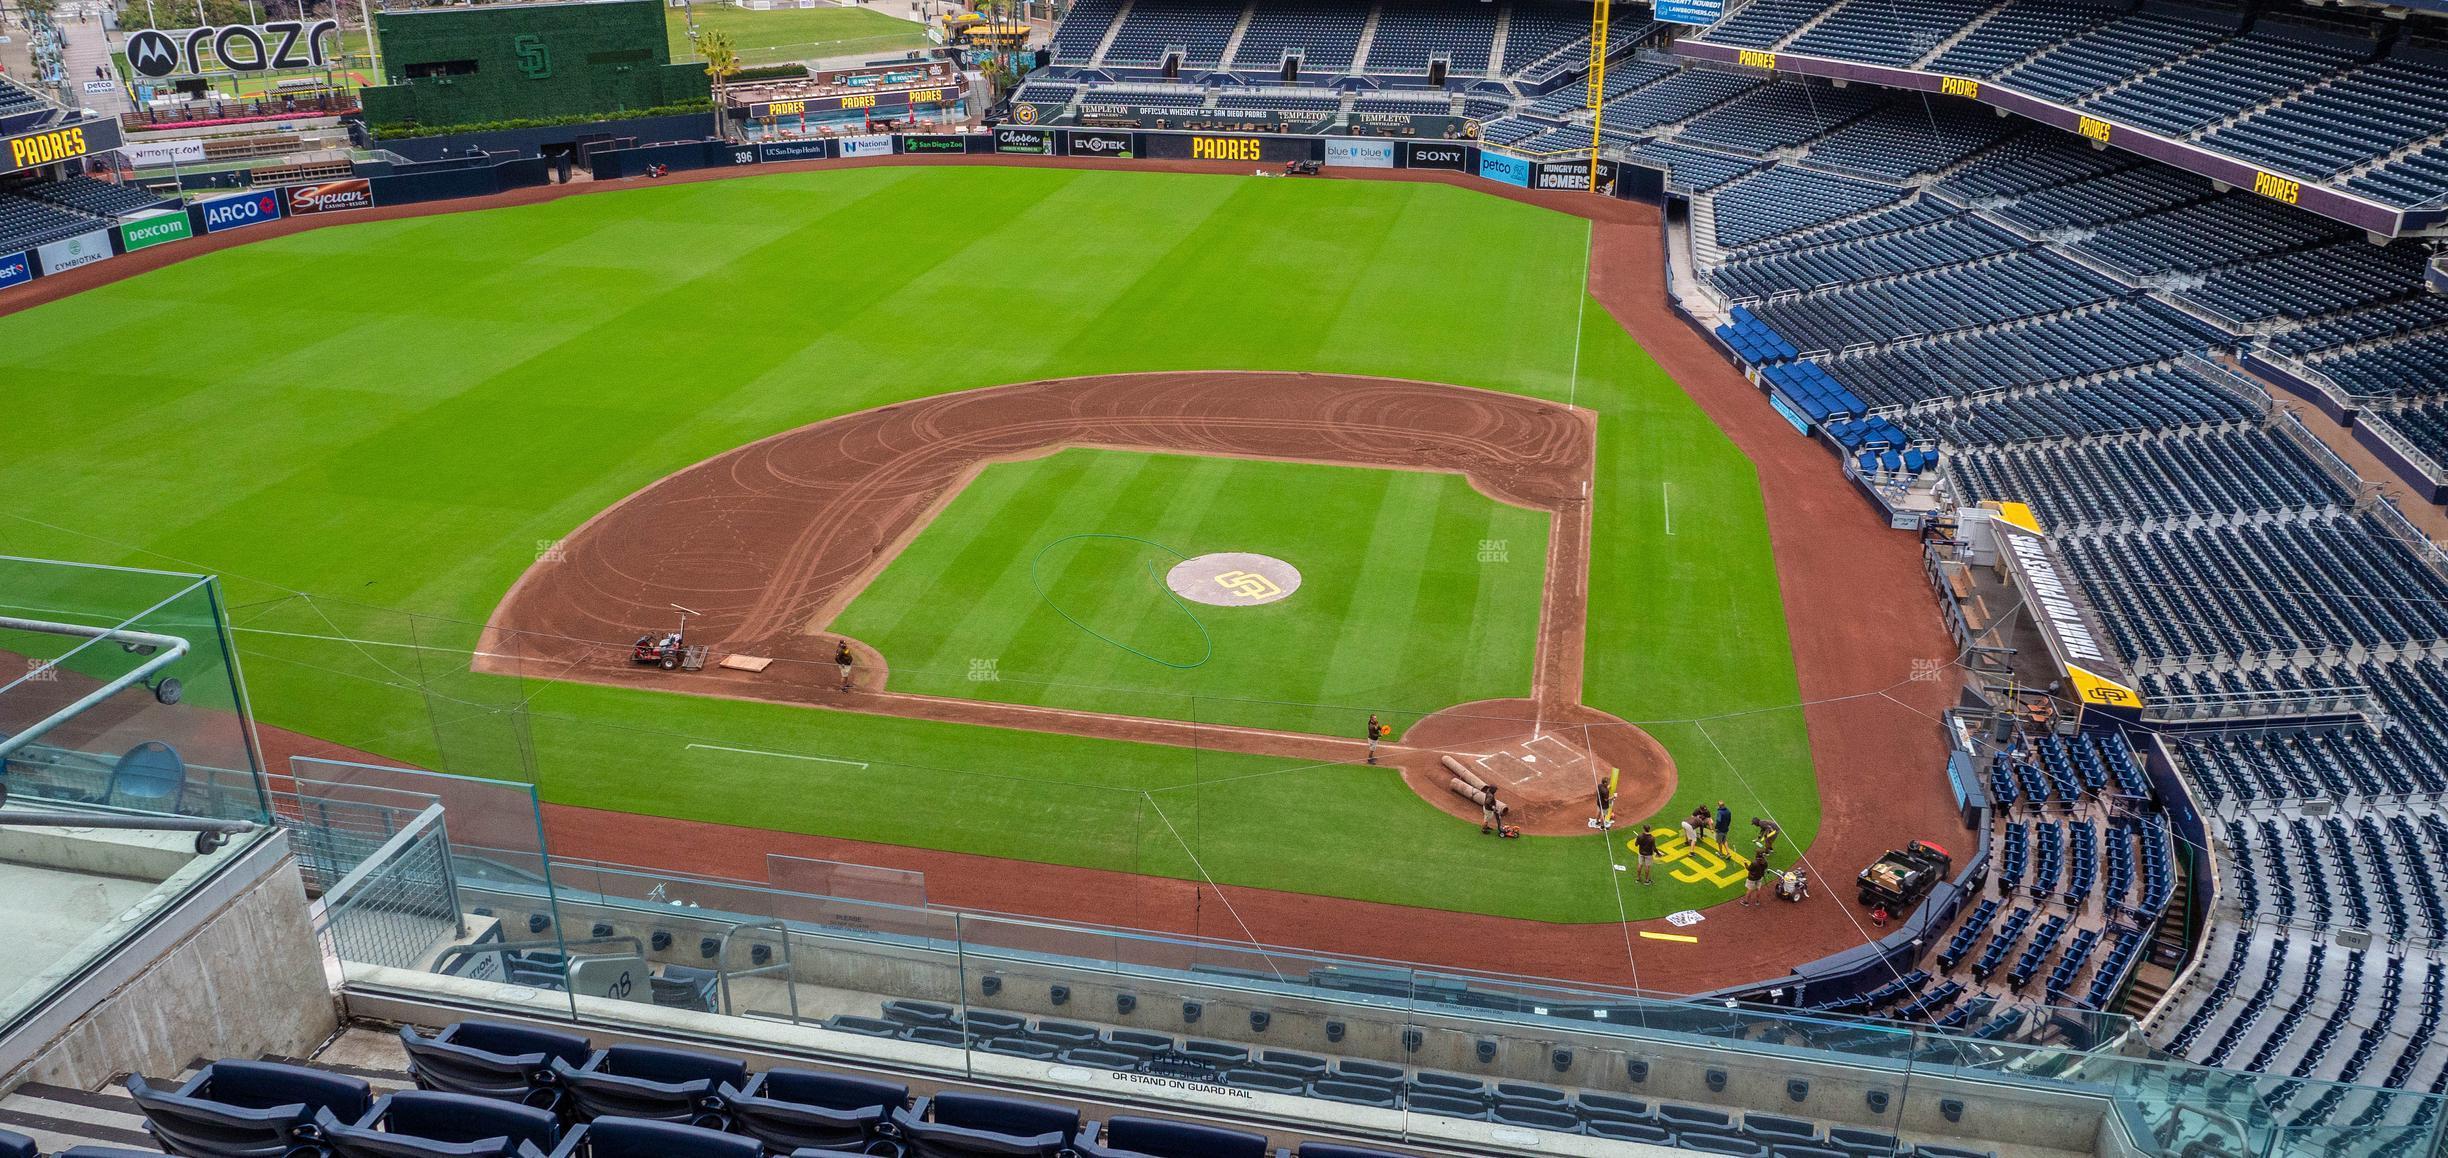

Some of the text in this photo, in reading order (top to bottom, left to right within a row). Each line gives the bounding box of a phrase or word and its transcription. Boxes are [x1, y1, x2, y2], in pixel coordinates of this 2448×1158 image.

[185, 21, 337, 75] razr
[1739, 50, 1776, 69] PADRES
[1942, 77, 1978, 99] PADRES
[841, 96, 875, 109] PADRES
[909, 89, 942, 104] PADRES
[769, 102, 805, 115] PADRES
[1081, 105, 1128, 115] TEMPLETON
[1140, 107, 1168, 115] OFFICIAL
[1169, 108, 1199, 116] WHISKEY
[1214, 109, 1226, 117] SAN
[1244, 110, 1267, 118] PADRES
[1278, 111, 1328, 120] TEMPLETON
[1360, 113, 1411, 124] TEMPLETON
[2079, 116, 2111, 142] PADRES
[858, 139, 889, 148] National
[1000, 130, 1040, 143] Chosen
[11, 127, 86, 168] PADRES
[786, 147, 802, 155] Diego
[931, 141, 949, 149] Diego
[1075, 137, 1125, 151] EVOTEK
[1192, 137, 1260, 160] PADRES
[1327, 147, 1348, 155] blue
[735, 151, 753, 163] 396
[1360, 148, 1381, 156] blue
[1416, 151, 1460, 162] SONY
[1483, 158, 1511, 174] petco
[1543, 164, 1588, 174] HUNGRY FOR
[1540, 173, 1590, 189] HOMERS
[2255, 171, 2299, 204] PADRES
[293, 186, 364, 211] Sycuan
[209, 201, 258, 225] ARCO
[55, 252, 102, 271] CYMBIOTIKA
[470, 955, 492, 979] TION
[1112, 1072, 1253, 1099] OR STAND ON GUARD RAIL
